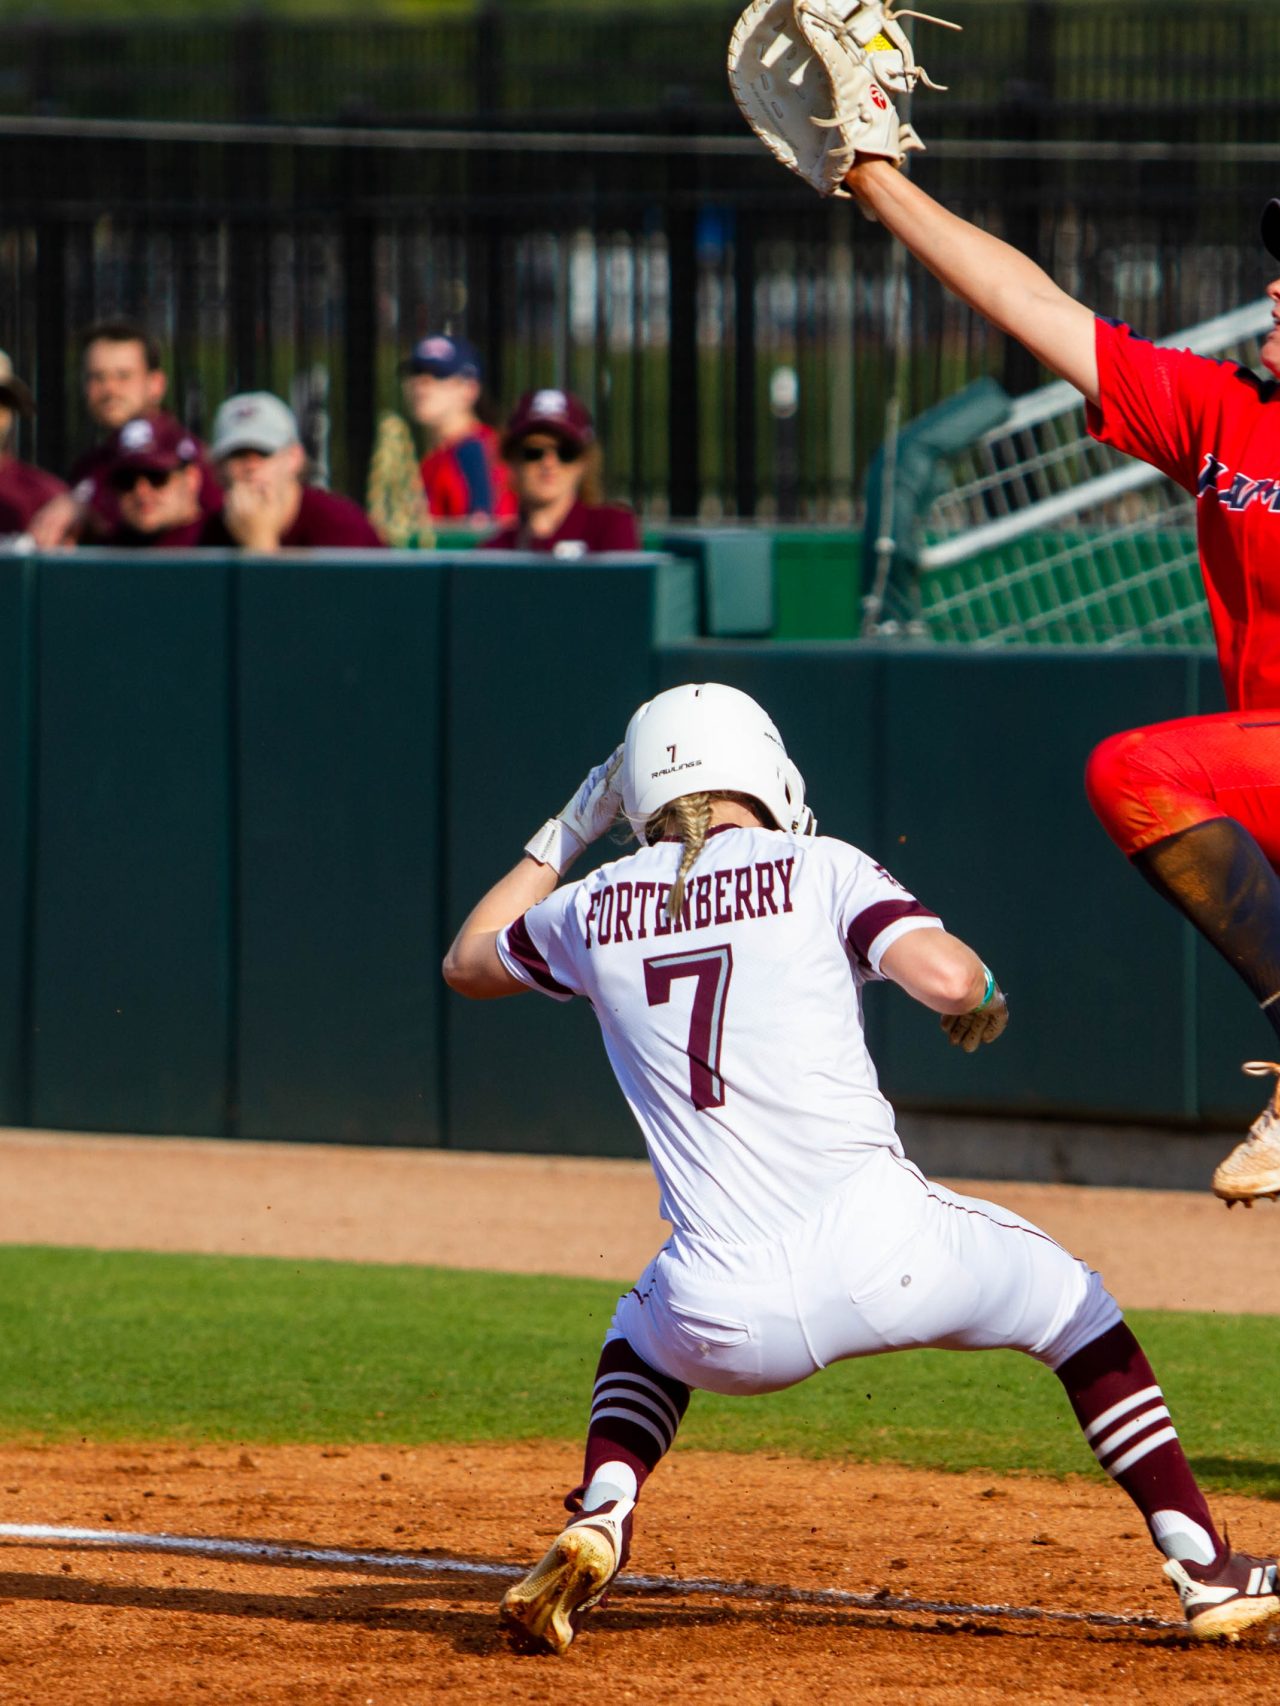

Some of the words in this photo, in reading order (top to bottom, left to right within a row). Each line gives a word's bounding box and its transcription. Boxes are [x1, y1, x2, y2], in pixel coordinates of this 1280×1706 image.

[651, 759, 702, 779] RAWLINGS
[666, 744, 677, 763] 7
[585, 856, 795, 949] FORTENBERRY
[643, 943, 733, 1112] 7
